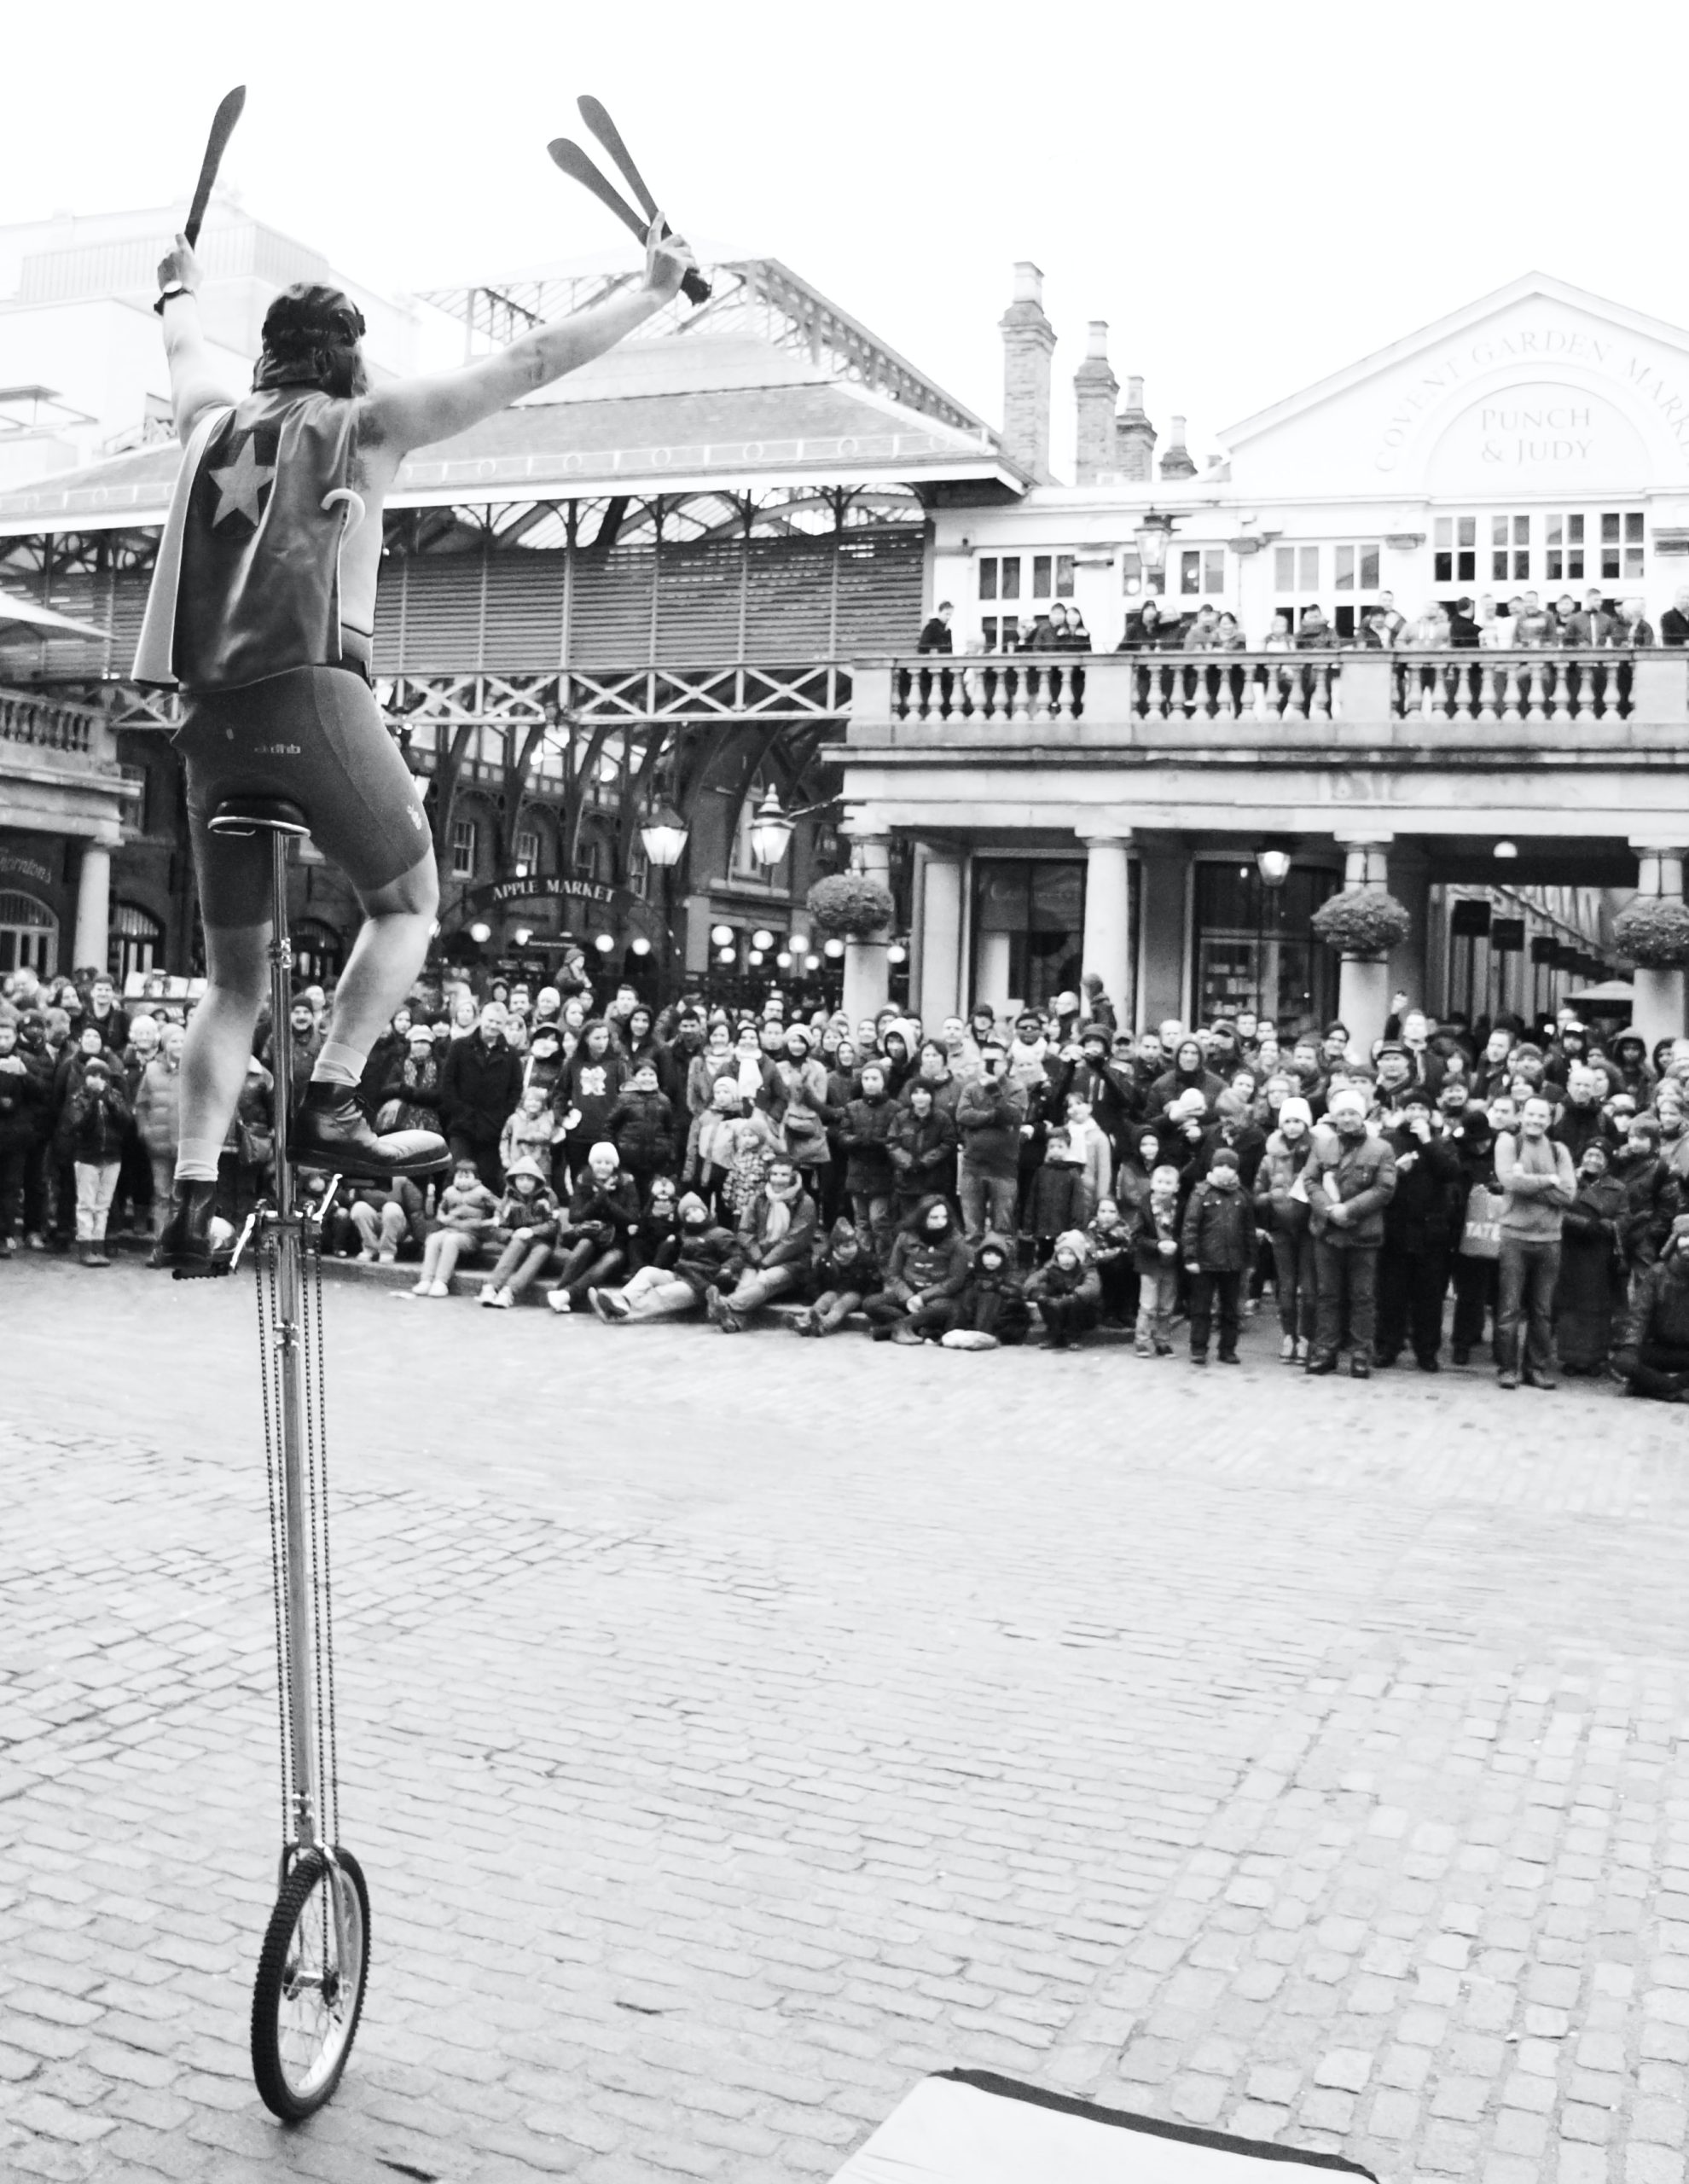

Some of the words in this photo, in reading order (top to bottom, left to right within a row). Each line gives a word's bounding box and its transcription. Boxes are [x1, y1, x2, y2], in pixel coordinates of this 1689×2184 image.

[1374, 357, 1460, 473] COVENT
[1471, 330, 1611, 366] GARDEN
[1482, 407, 1590, 431] PUNCH
[1481, 439, 1503, 463] &
[1517, 439, 1593, 467] JUDY
[493, 880, 537, 901] APPLE
[547, 879, 616, 903] MARKET
